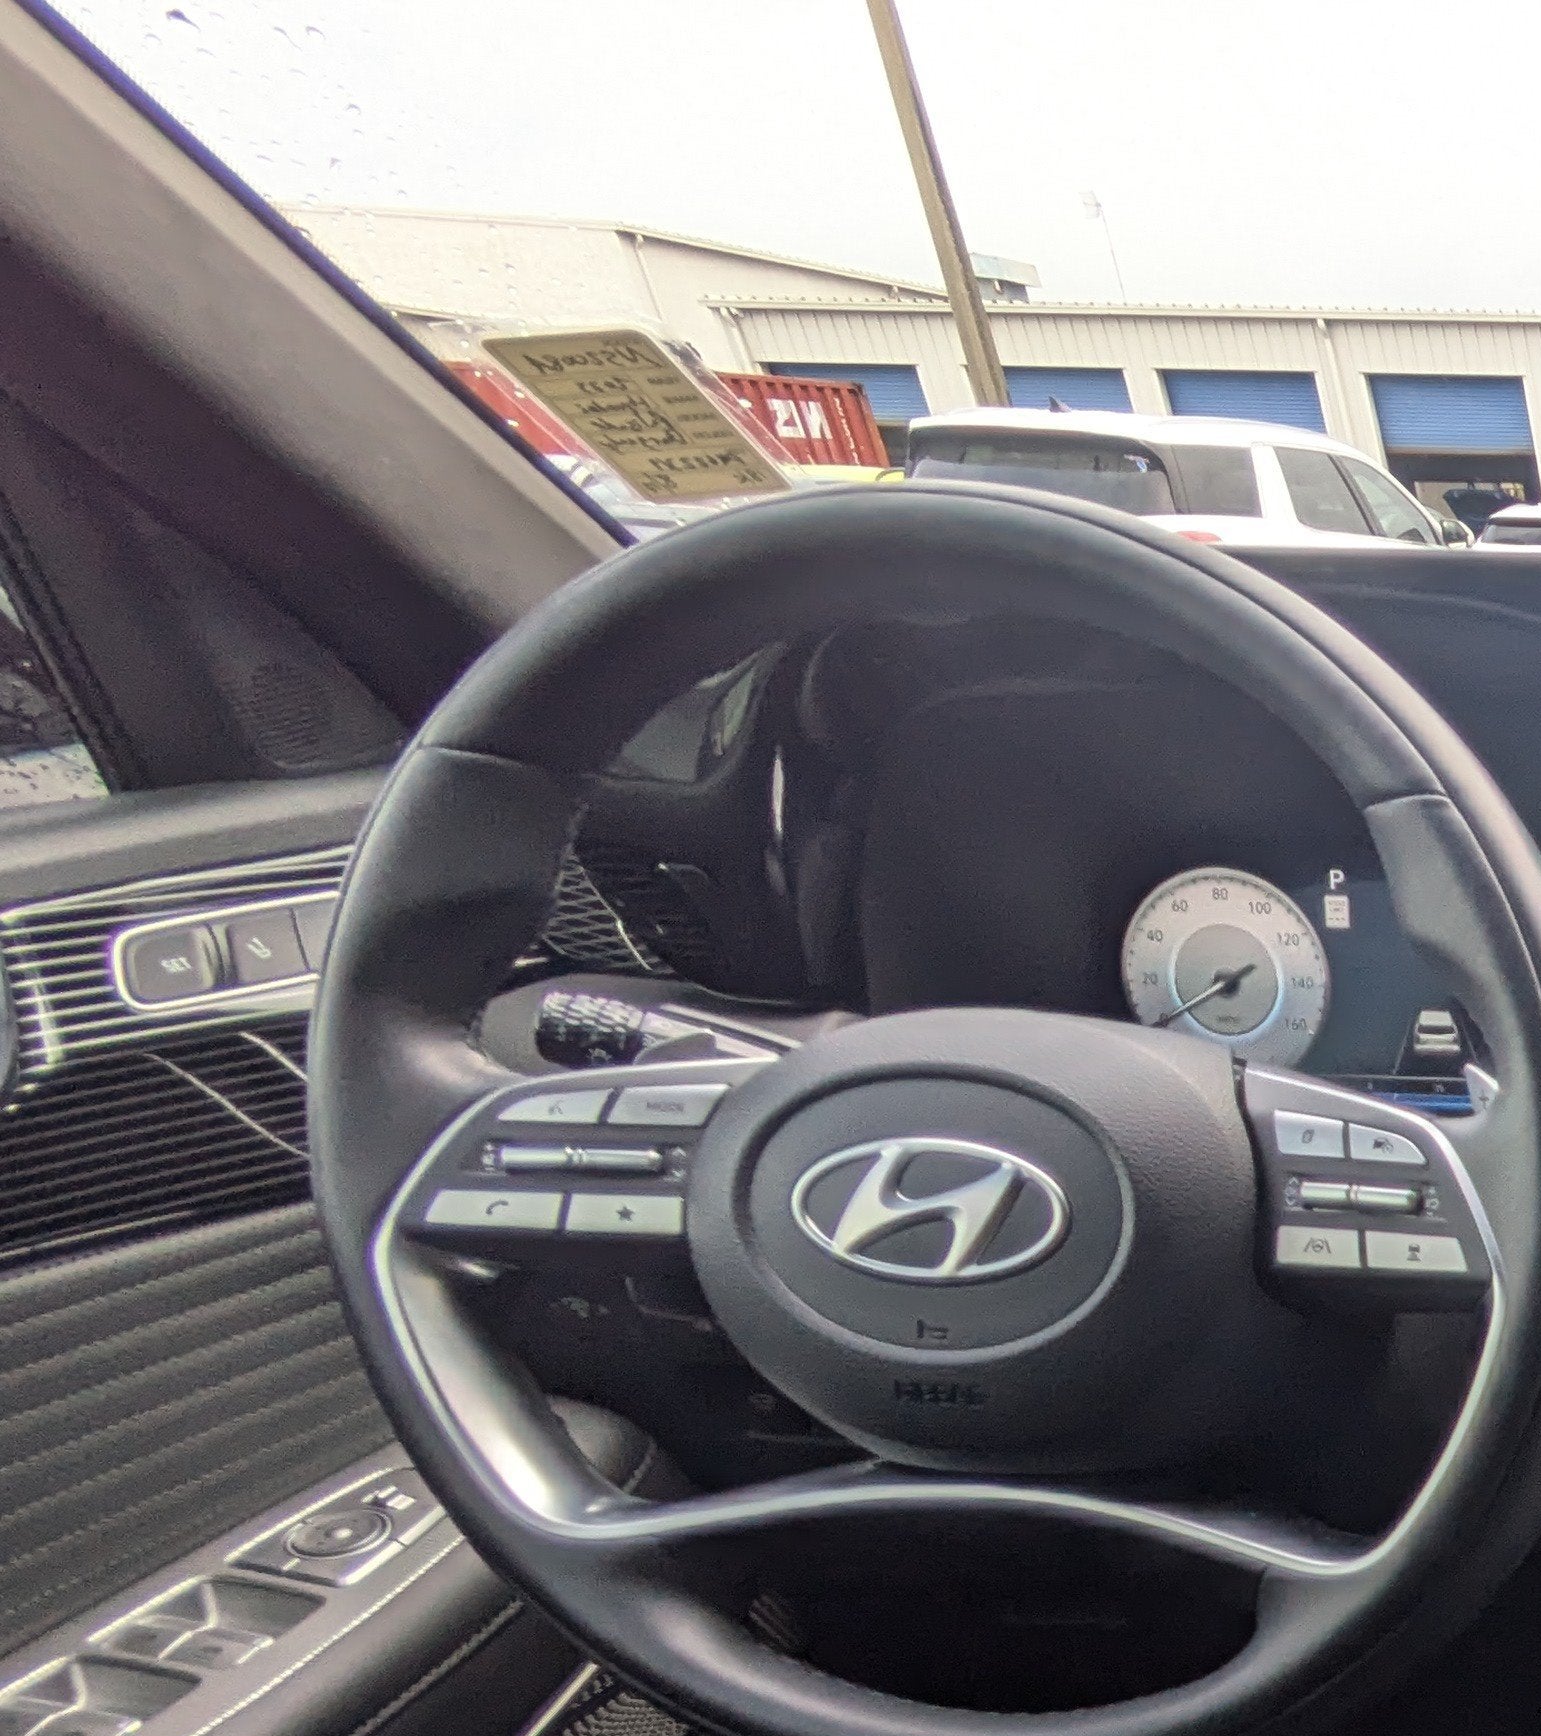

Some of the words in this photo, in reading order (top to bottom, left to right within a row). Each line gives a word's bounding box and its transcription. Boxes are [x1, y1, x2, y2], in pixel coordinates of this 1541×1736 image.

[1330, 869, 1345, 890] P
[1212, 888, 1228, 900] 80
[1171, 900, 1188, 912] 60
[1249, 902, 1272, 914] 100
[1147, 930, 1163, 942] 40
[1277, 933, 1300, 946] 120
